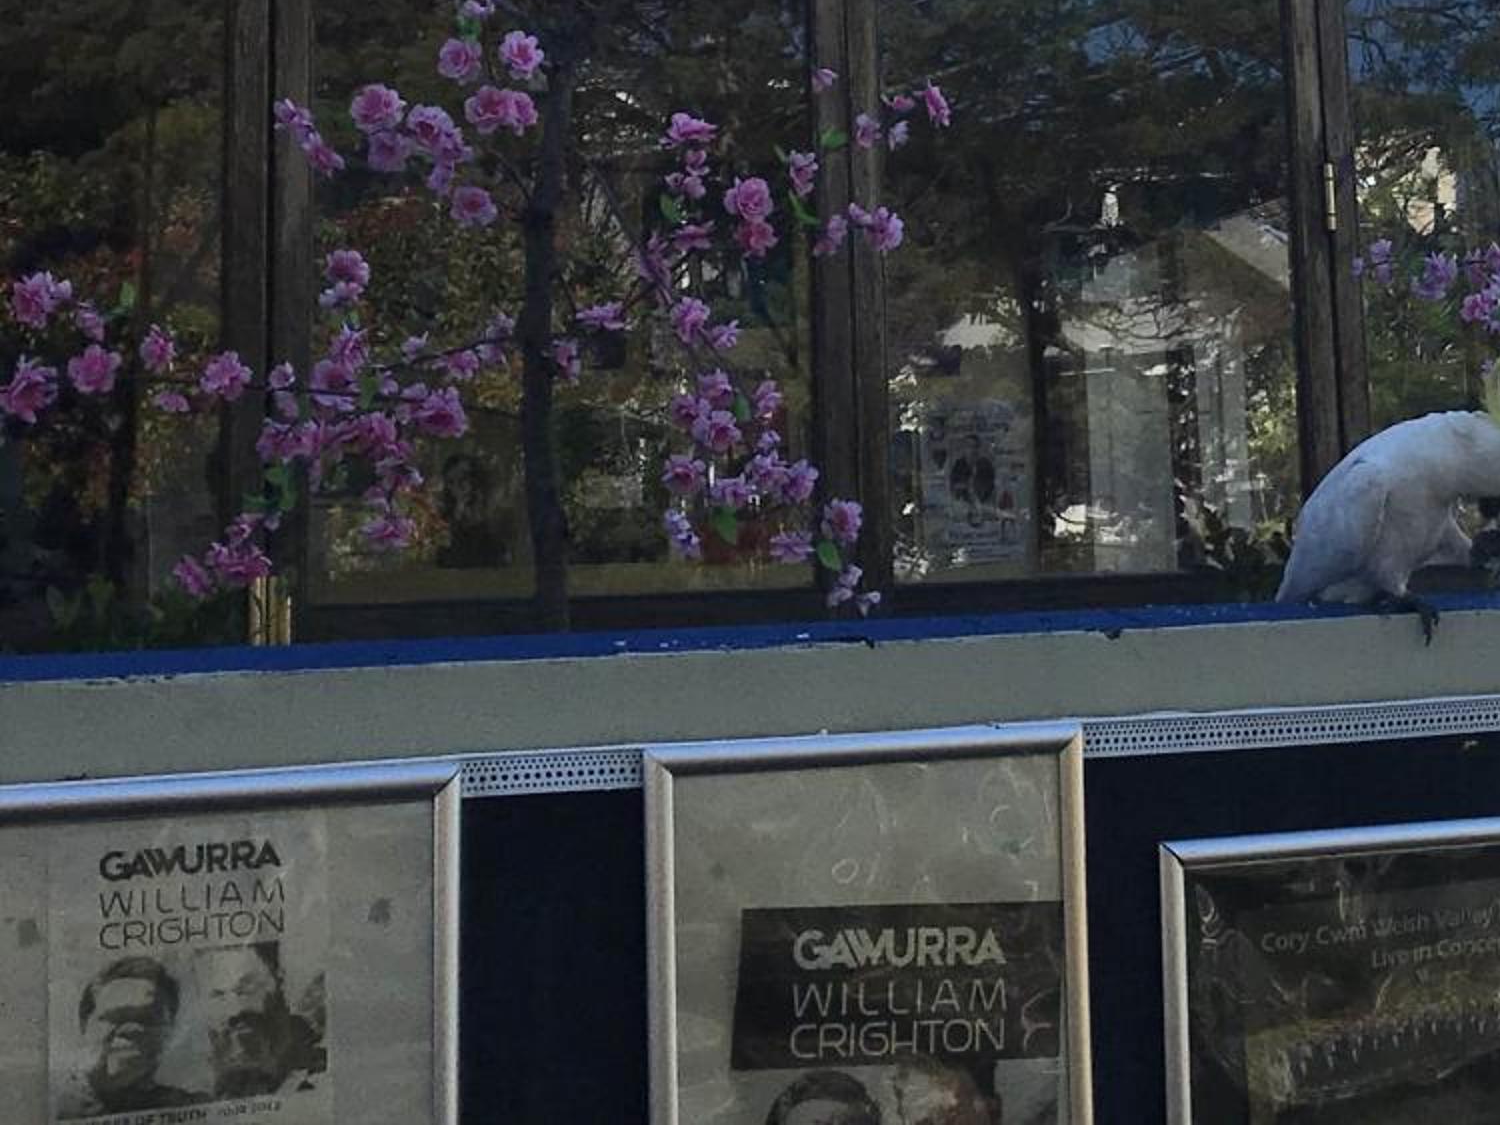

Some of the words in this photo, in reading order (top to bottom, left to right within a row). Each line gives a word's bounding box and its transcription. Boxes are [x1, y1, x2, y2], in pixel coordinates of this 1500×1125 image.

[100, 839, 281, 881] GAWURRA
[100, 877, 285, 918] WILLIAM
[100, 908, 284, 949] CRIGHTON
[793, 927, 1007, 970] GAWURRA
[1261, 932, 1310, 954] Cory
[1316, 925, 1367, 945] Cwm
[1372, 949, 1411, 968] Live
[1413, 945, 1433, 962] in
[793, 978, 1007, 1017] WILLIAM
[791, 1018, 1005, 1059] CRIGHTON
